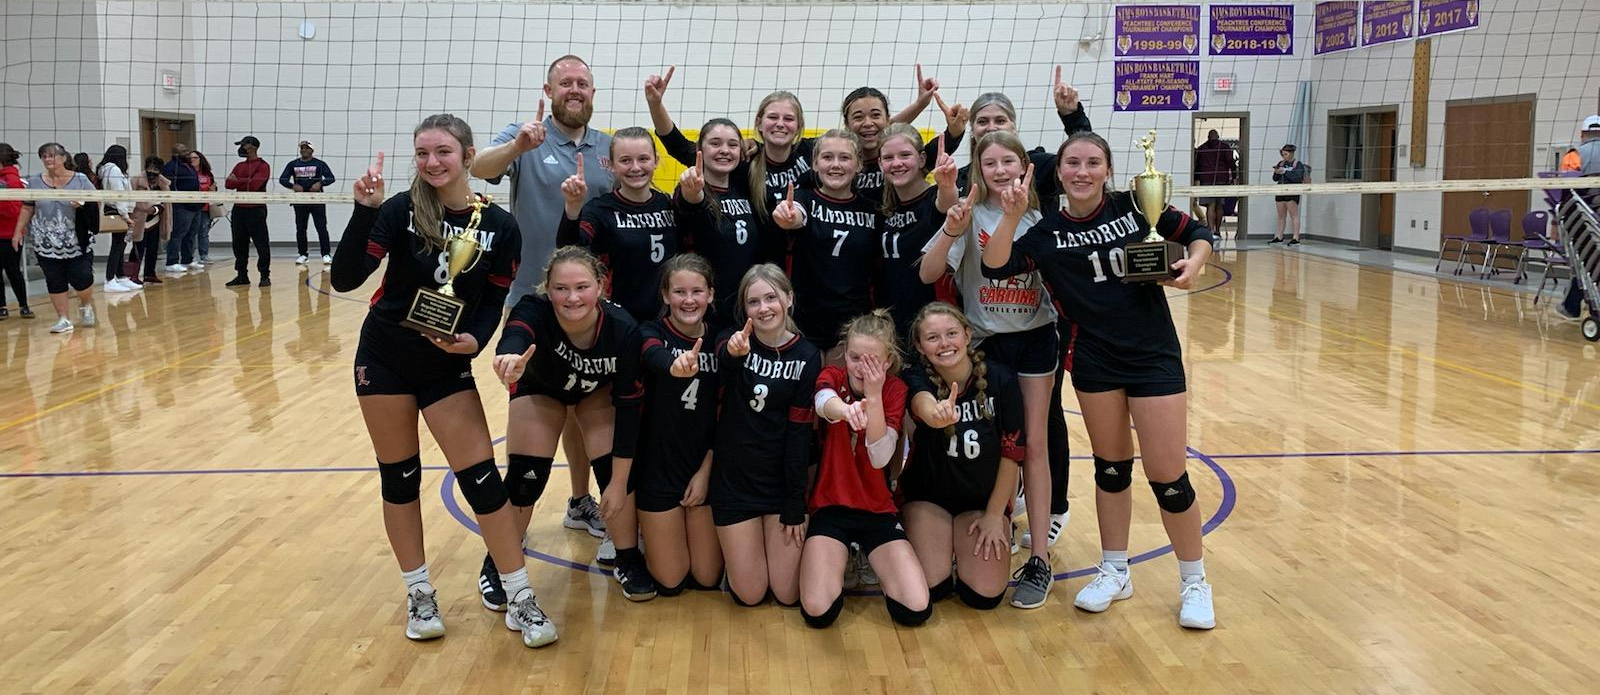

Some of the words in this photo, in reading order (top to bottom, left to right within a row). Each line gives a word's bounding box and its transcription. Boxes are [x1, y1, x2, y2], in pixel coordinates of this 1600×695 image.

[1117, 7, 1134, 20] SIMS
[1135, 7, 1153, 18] BOYS
[1154, 7, 1199, 21] BASKETBALL
[1211, 6, 1228, 20] SIMS
[1229, 6, 1247, 17] BOYS
[1248, 6, 1292, 20] BASKETBALL
[1434, 8, 1462, 27] 2017
[1326, 32, 1345, 47] 2002
[1375, 21, 1398, 38] 2012
[1133, 40, 1182, 50] 1998-99
[1227, 39, 1276, 50] 2018-19
[1116, 62, 1133, 77] SIMS
[1134, 62, 1152, 74] BOYS
[1153, 62, 1198, 76] BASKETBALL
[1142, 95, 1171, 105] 2021
[811, 200, 876, 229] LANDRUM
[735, 220, 748, 245] 6
[832, 229, 850, 257] 7
[1053, 212, 1140, 249] LANDRUM
[650, 234, 665, 263] 5
[434, 251, 450, 284] 8
[1087, 247, 1126, 283] 10
[744, 352, 806, 381] NDRUM
[681, 379, 700, 410] 4
[750, 384, 769, 412] 3
[954, 397, 996, 422] DRUM
[947, 429, 981, 460] 16
